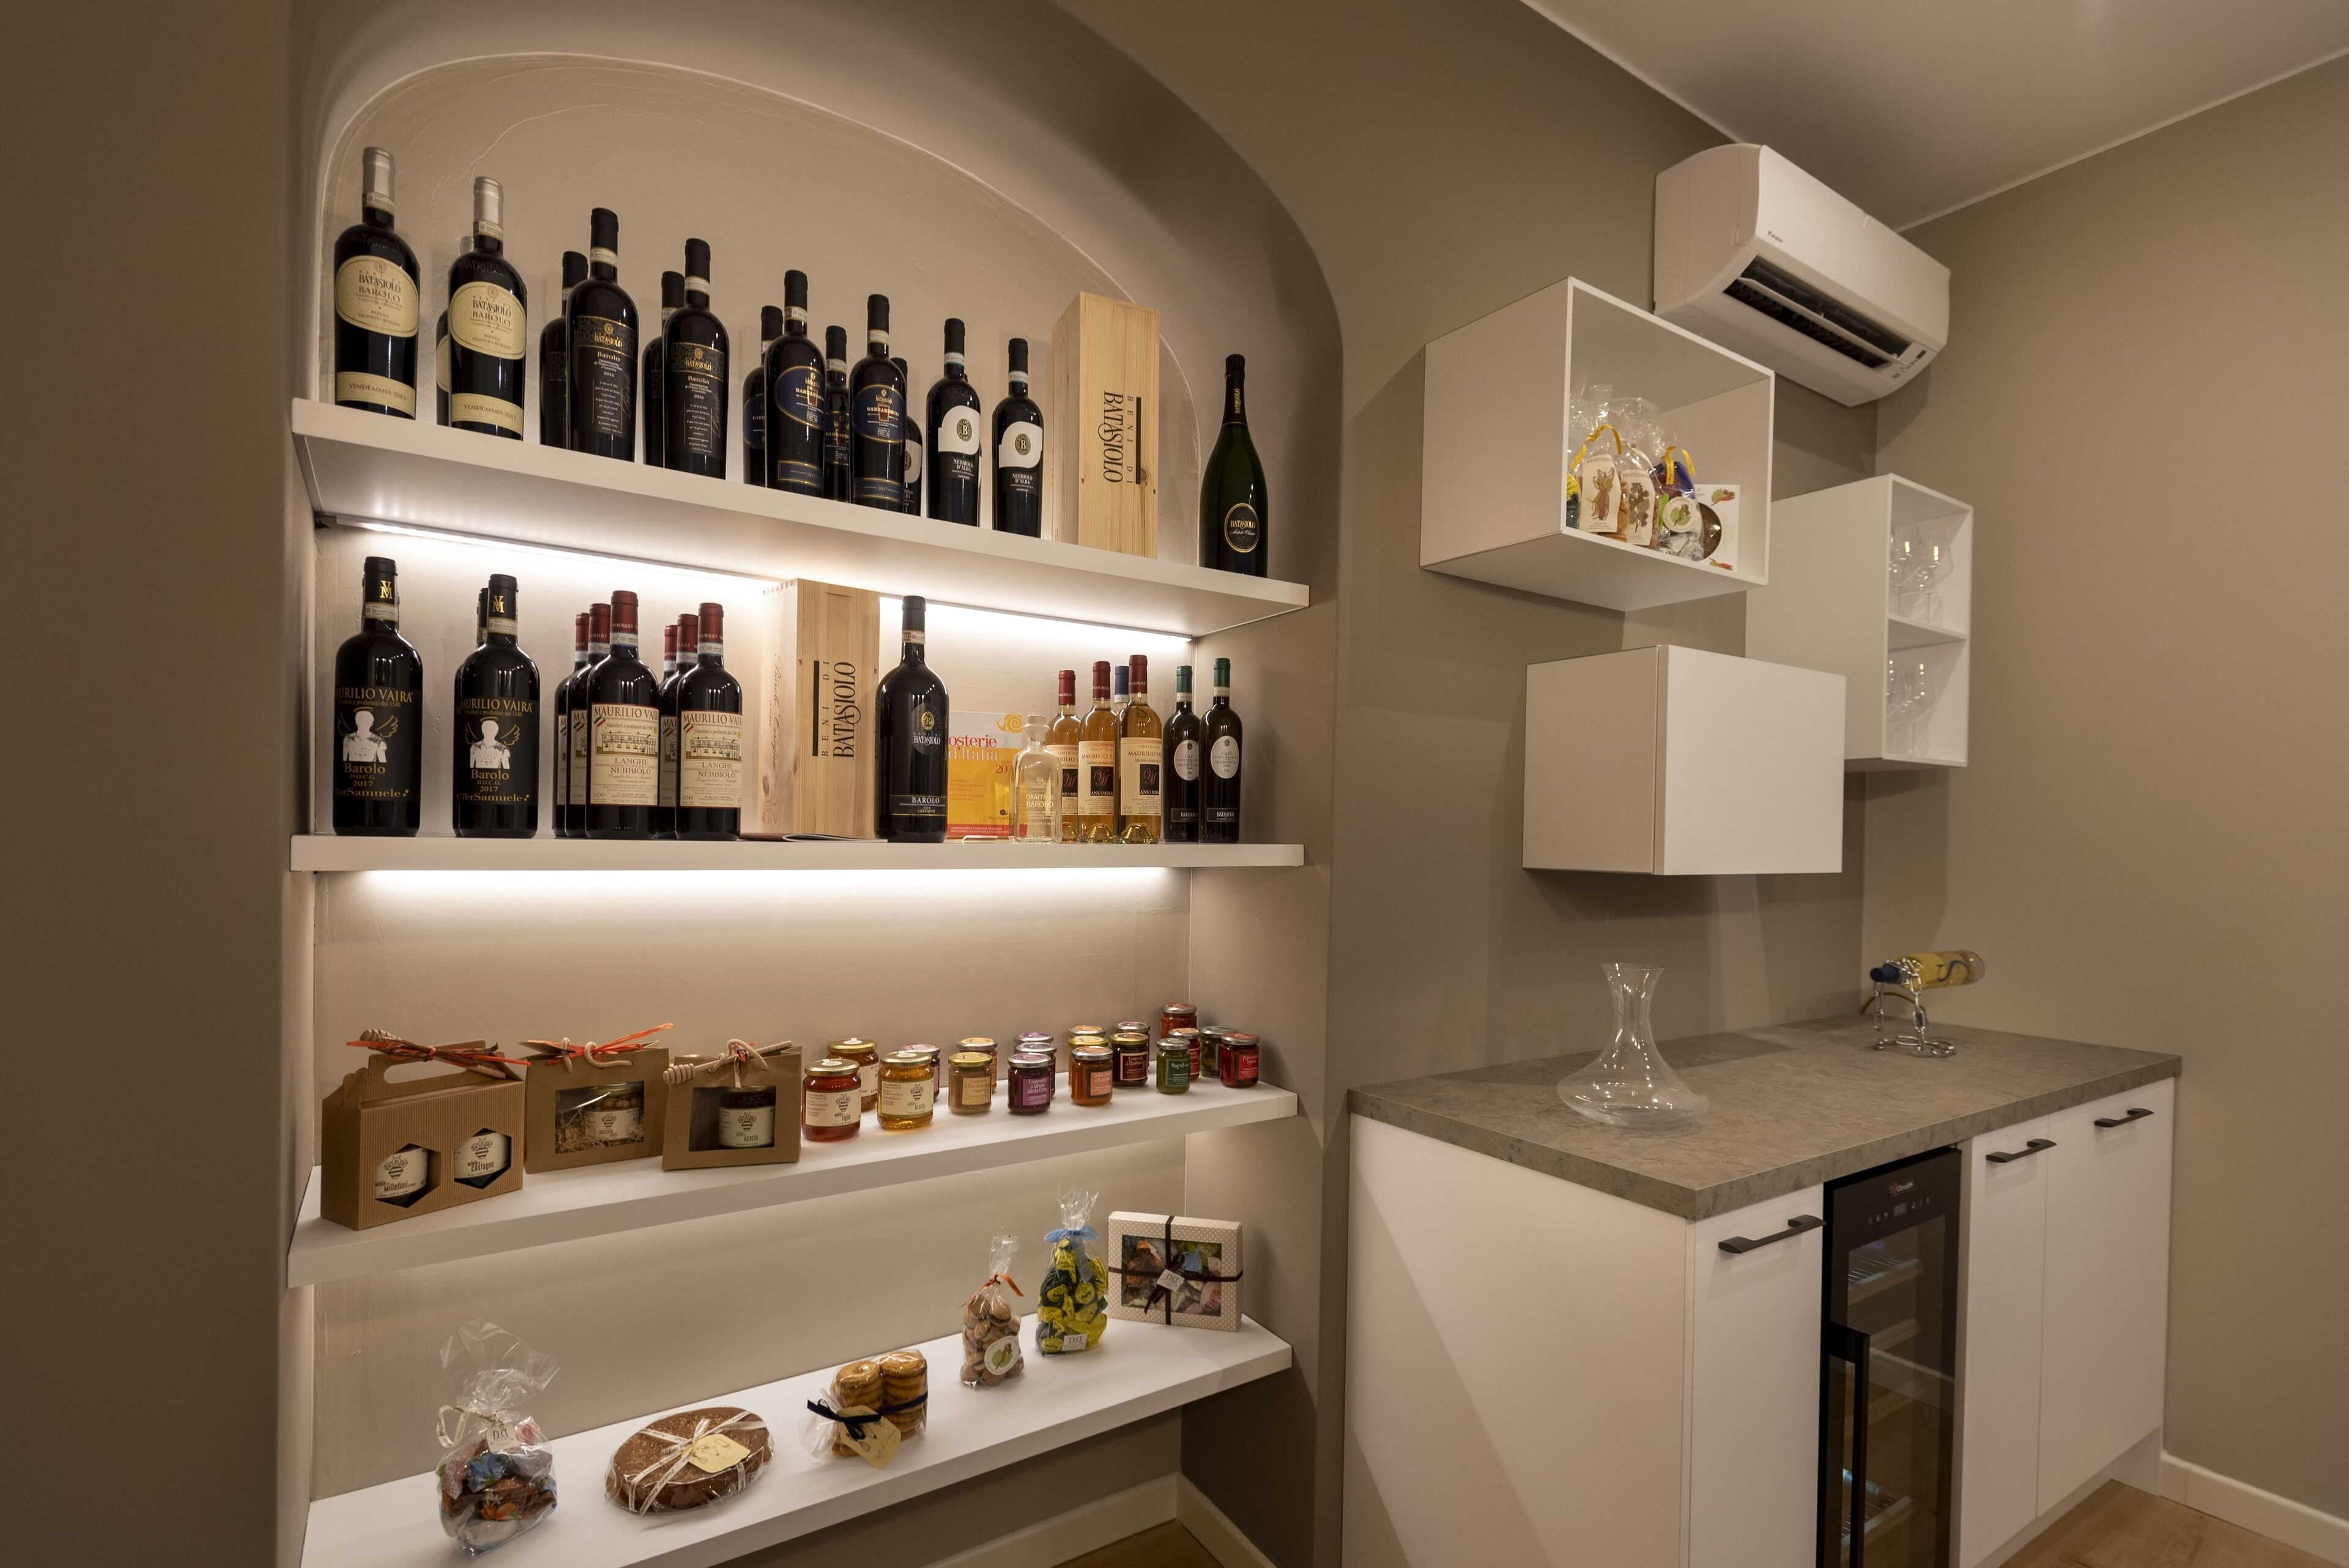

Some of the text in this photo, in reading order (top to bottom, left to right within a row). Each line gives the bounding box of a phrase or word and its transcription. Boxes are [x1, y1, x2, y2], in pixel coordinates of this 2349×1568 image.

[358, 274, 401, 293] BATASIOLO
[358, 286, 401, 302] BAROLO
[472, 299, 511, 317] BATASIOLO
[472, 310, 511, 327] BAROLO
[597, 351, 621, 362] Barolo
[688, 375, 710, 385] Barolo
[348, 382, 392, 397] VENDEMMIA
[463, 404, 503, 417] VENDEMMIA
[1097, 390, 1124, 483] BATASIOLO
[953, 459, 974, 469] NEBBIOLO
[956, 464, 971, 472] D'ALBA
[1126, 466, 1134, 484] DI
[1230, 519, 1256, 529] BATASIOLO
[593, 707, 642, 718] MAURILIO
[644, 709, 659, 721] VAIR
[821, 661, 830, 757] BENI DI
[833, 661, 861, 759] BATASIOLO
[683, 713, 727, 724] MAURILIO
[913, 735, 941, 746] BATASIOLO
[949, 734, 997, 748] osterie
[949, 746, 998, 761] d'Italia
[344, 762, 386, 775] Barolo
[471, 769, 510, 781] Barolo
[610, 767, 651, 775] NEBBIOLO
[470, 1161, 494, 1172] castagno
[384, 1180, 409, 1192] Millefiori
